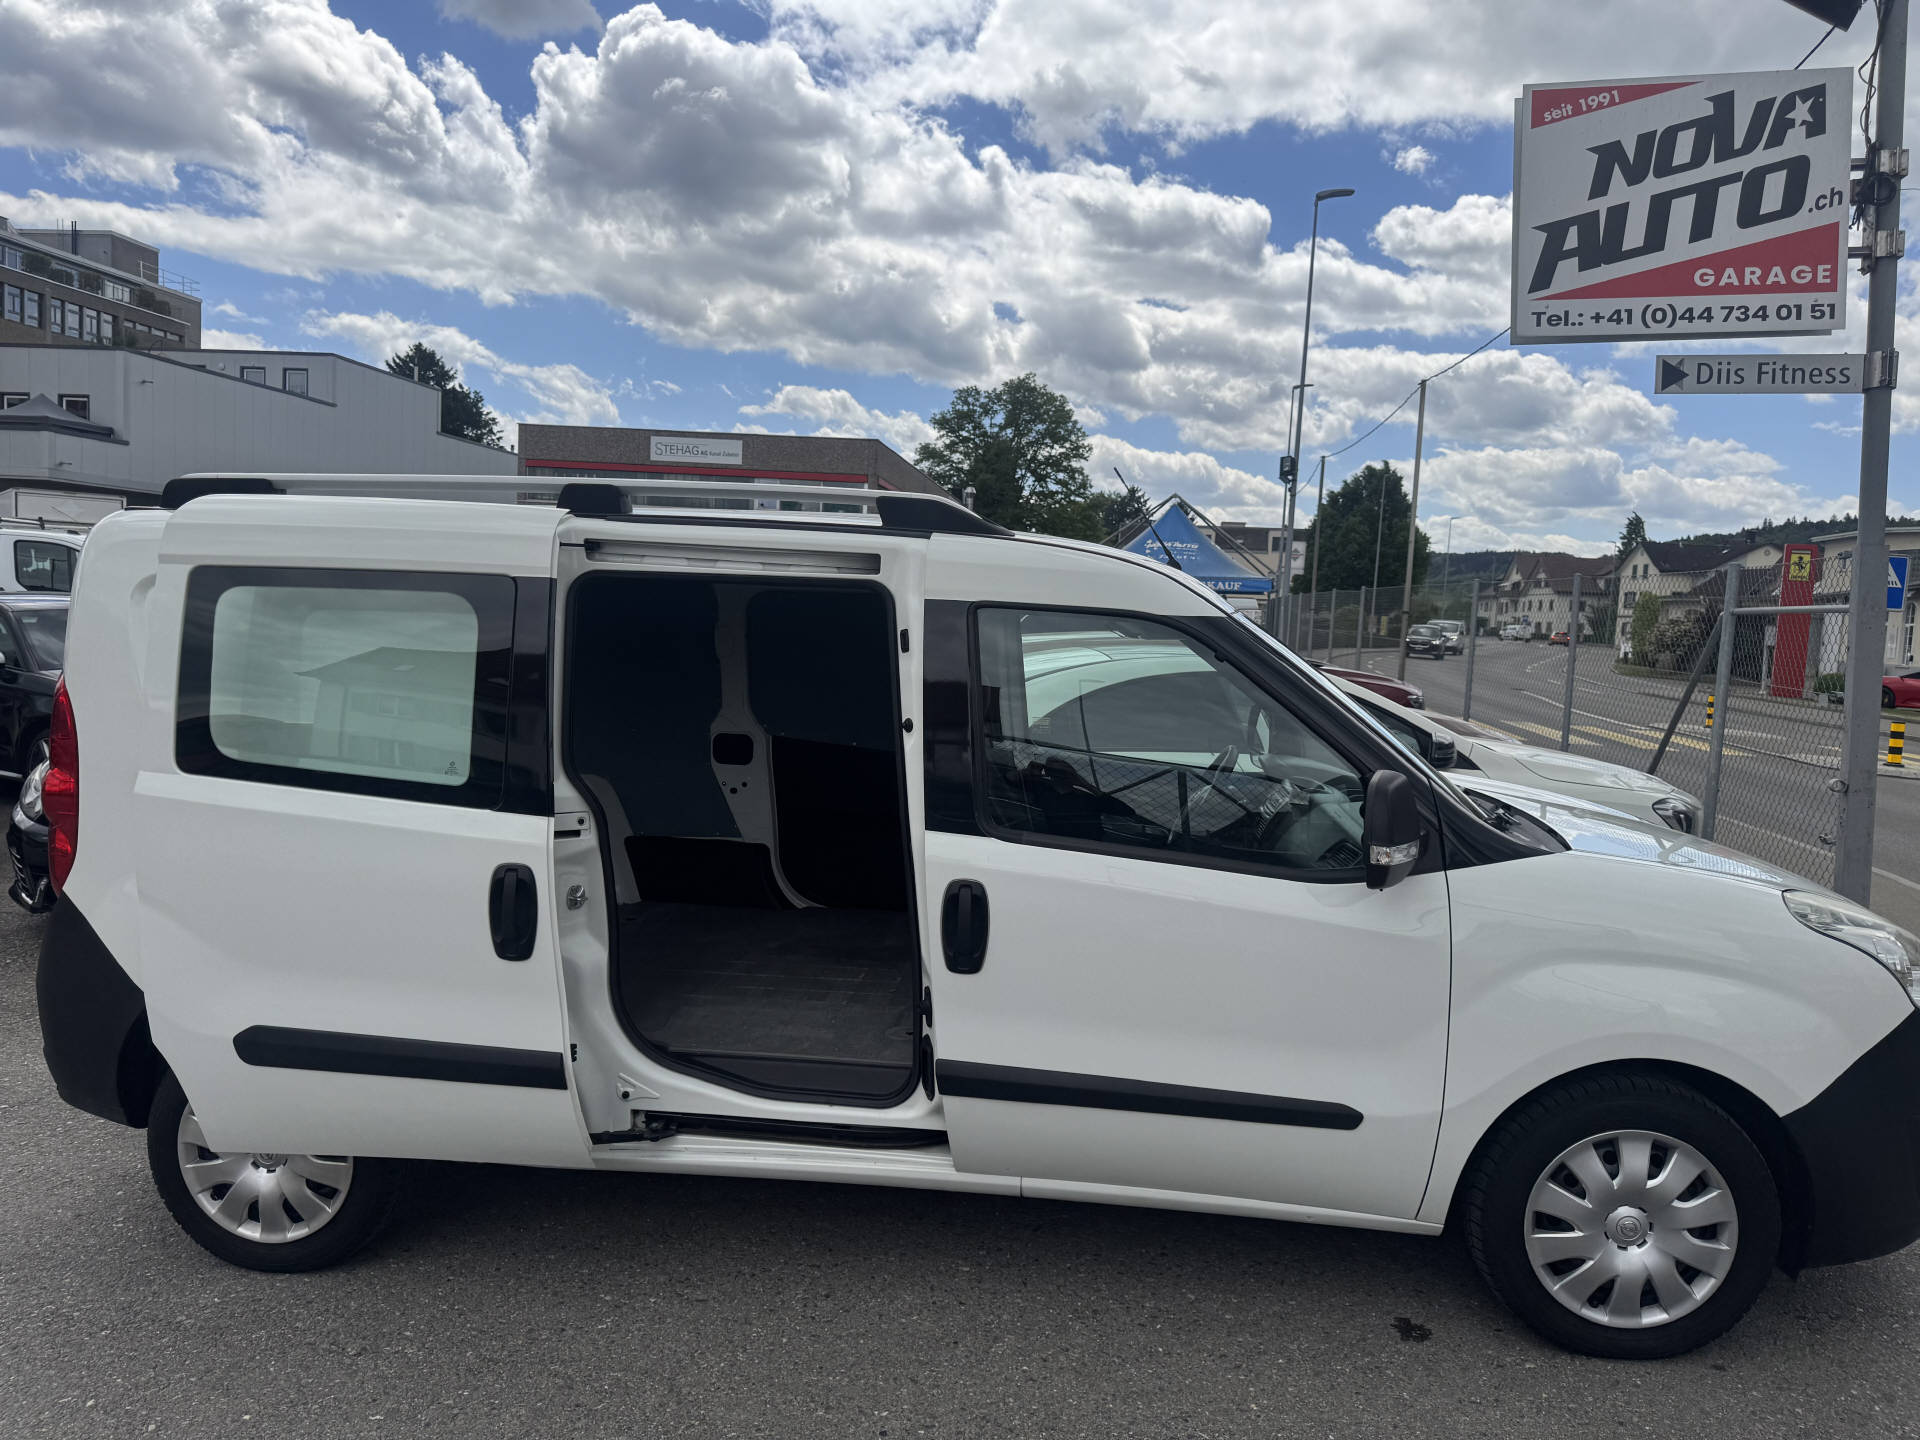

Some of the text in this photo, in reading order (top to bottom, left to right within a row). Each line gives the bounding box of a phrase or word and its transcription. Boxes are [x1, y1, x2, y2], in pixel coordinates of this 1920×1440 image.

[1543, 89, 1620, 122] seit 1991
[1585, 82, 1827, 201] NOVA
[1693, 264, 1832, 287] GARAGE
[1531, 310, 1584, 328] Tel.:
[1590, 308, 1633, 326] +41
[1720, 305, 1770, 323] 734
[1775, 304, 1802, 321] 01
[1810, 303, 1836, 320] 51
[1696, 361, 1851, 385] Diis Fitness
[655, 442, 700, 456] STEHAG
